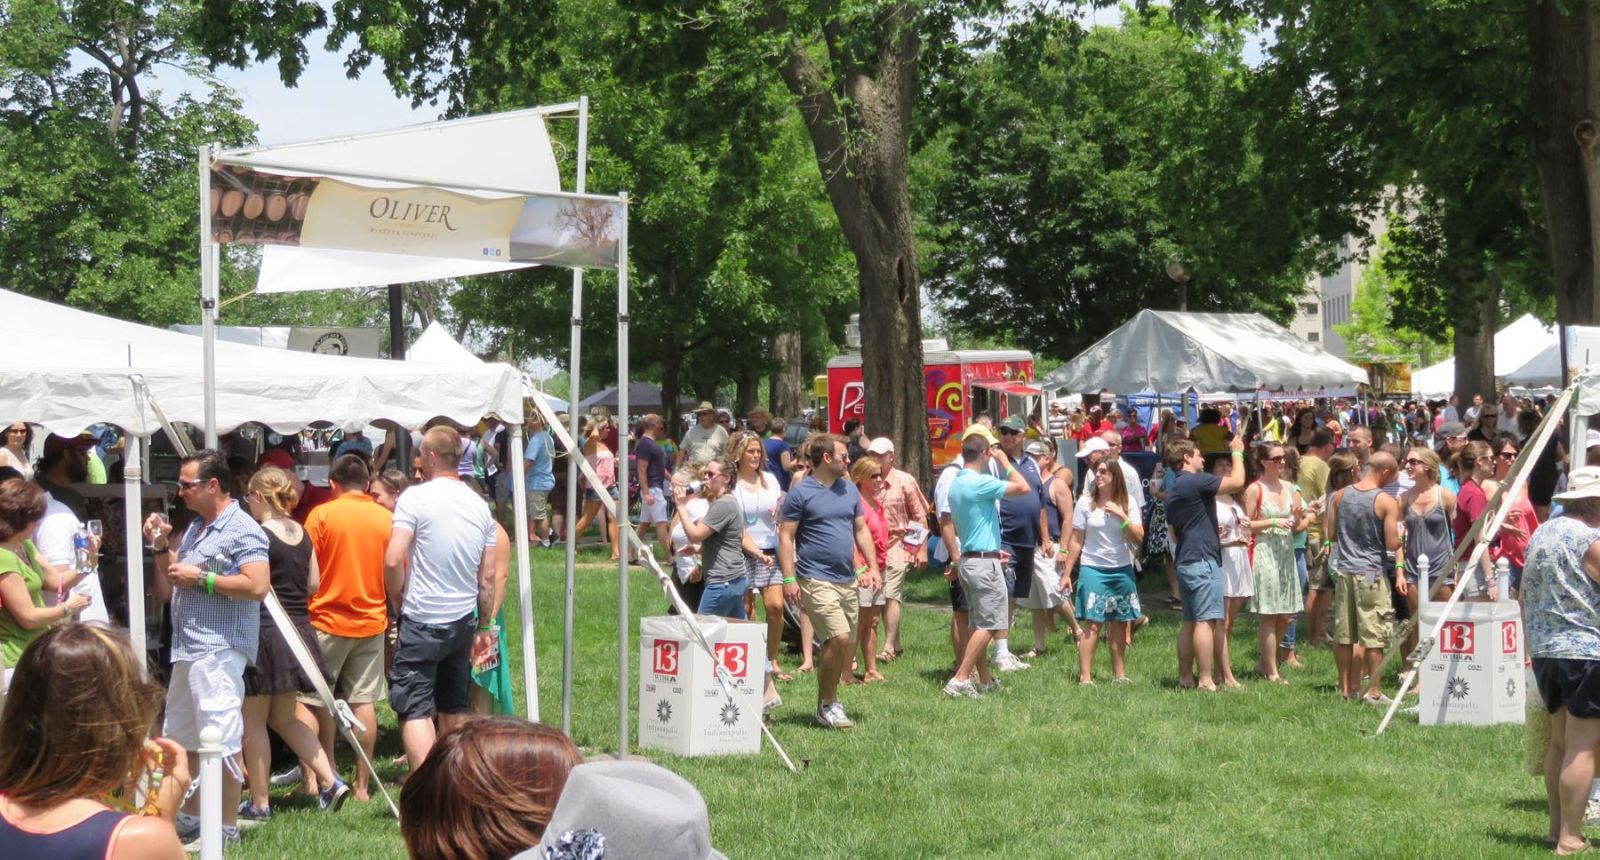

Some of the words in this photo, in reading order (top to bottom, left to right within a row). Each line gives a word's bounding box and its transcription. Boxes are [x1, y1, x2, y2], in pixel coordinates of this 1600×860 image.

[369, 196, 458, 231] OLIVER
[1441, 624, 1472, 651] 13
[1503, 623, 1516, 651] 13
[655, 643, 677, 673] 13
[715, 645, 745, 675] 13
